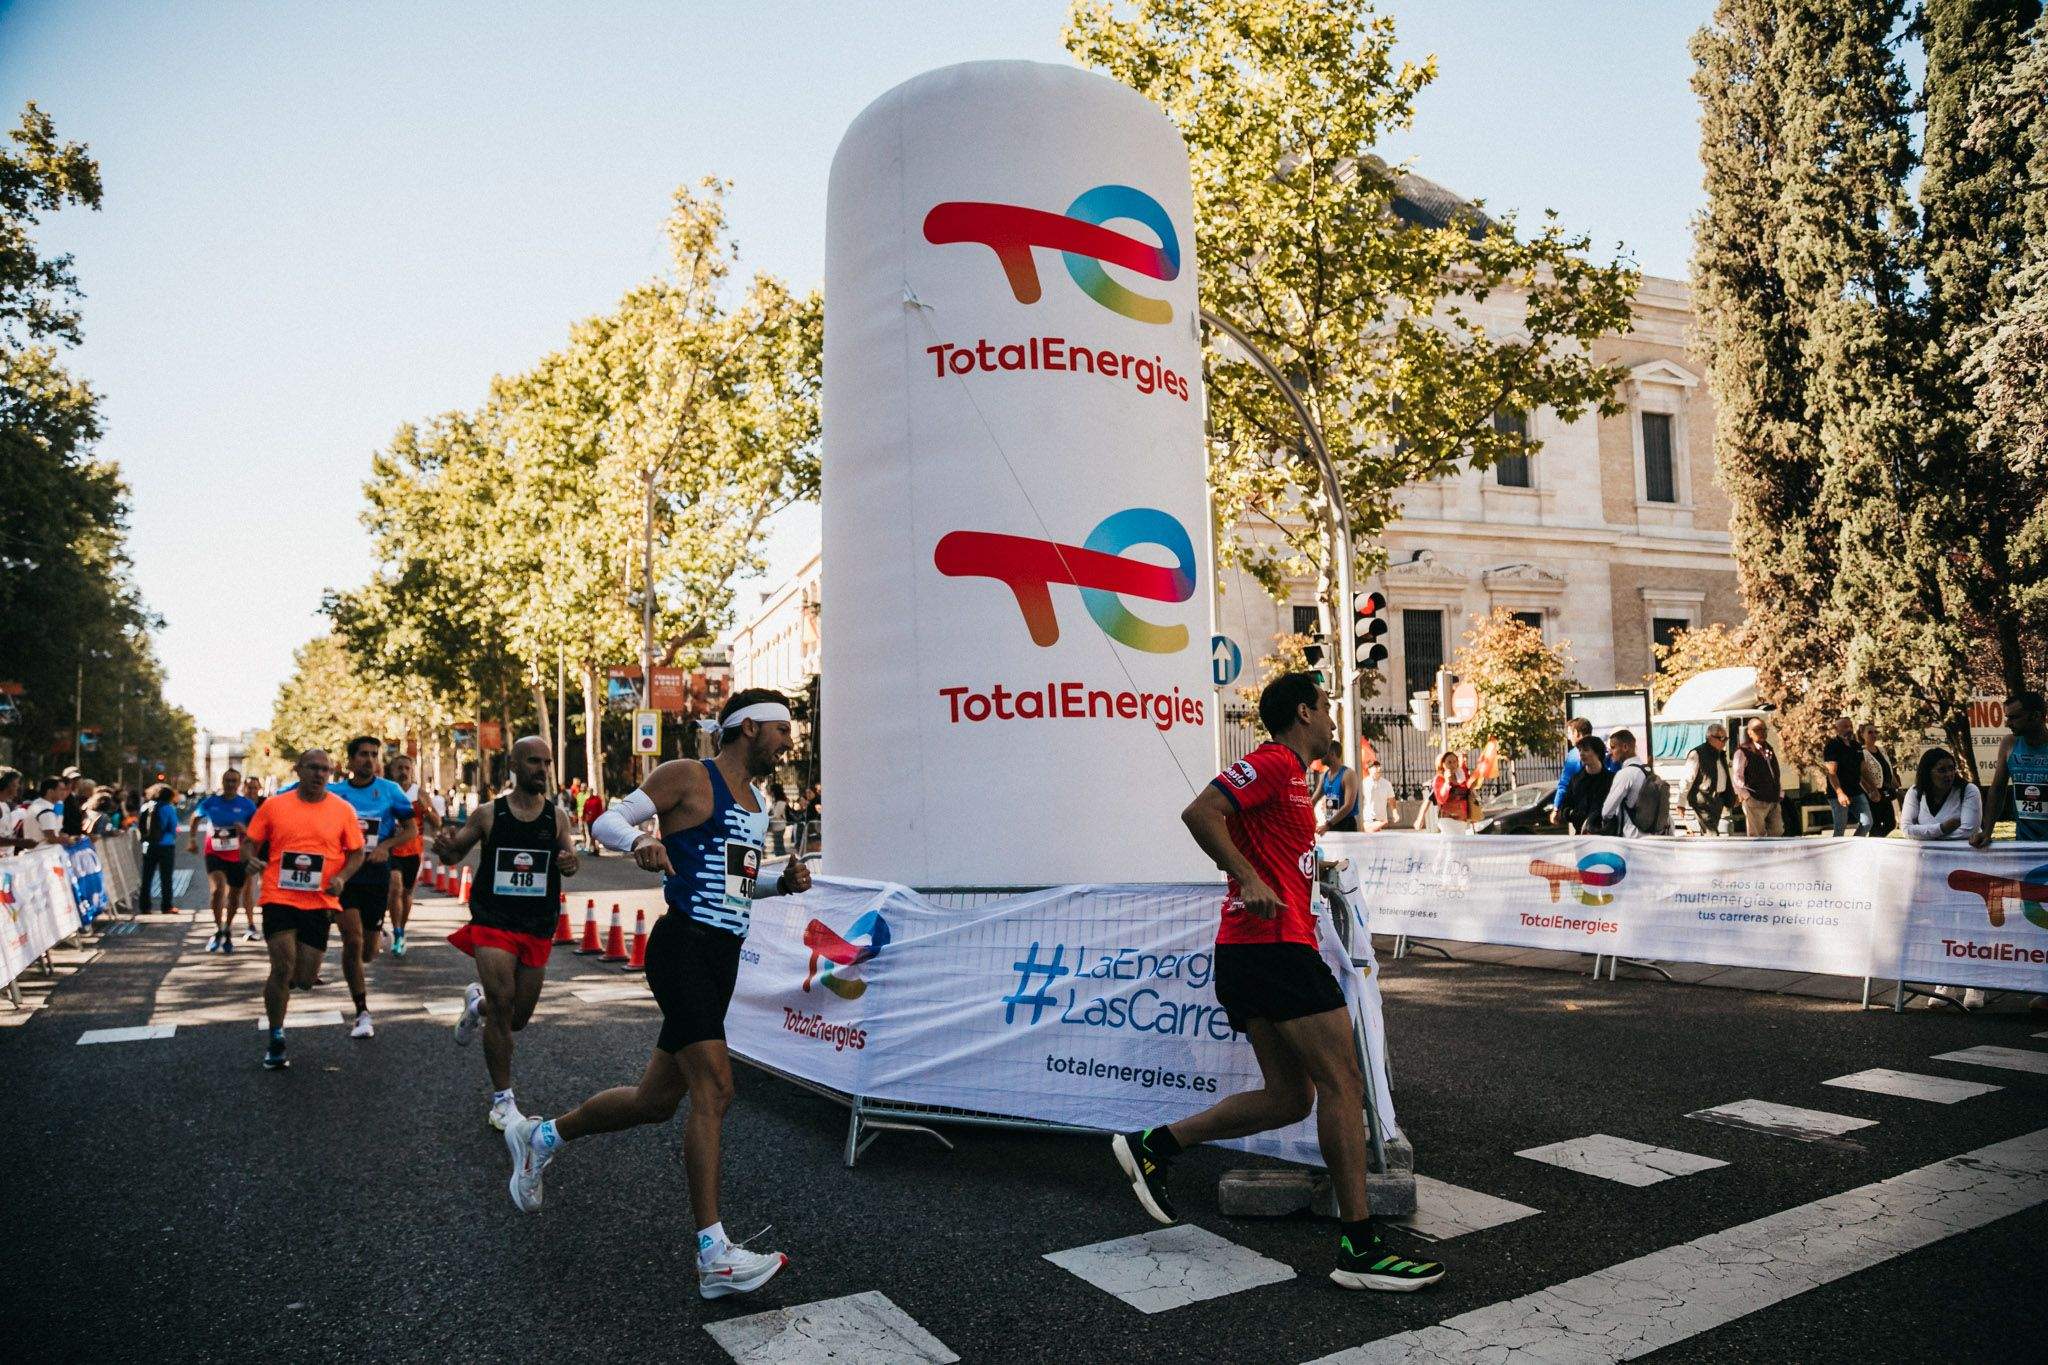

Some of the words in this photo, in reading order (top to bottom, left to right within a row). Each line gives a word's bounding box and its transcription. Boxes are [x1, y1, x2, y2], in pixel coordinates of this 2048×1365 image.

[926, 337, 1189, 402] TotalEnergies
[939, 682, 1204, 731] TotalEnergies
[2022, 801, 2043, 812] 254
[510, 871, 534, 887] 418
[1807, 897, 1872, 910] patrocina
[1520, 912, 1618, 935] TotalEnergies
[1698, 910, 1716, 920] tus
[1719, 912, 1769, 923] carreras
[1772, 914, 1839, 926] preferidas
[1942, 939, 2048, 963] TotalEne
[1075, 946, 1216, 989] LaEnerg
[783, 1006, 867, 1051] TotalEnergies
[1046, 1054, 1218, 1093] totalenergies.es
